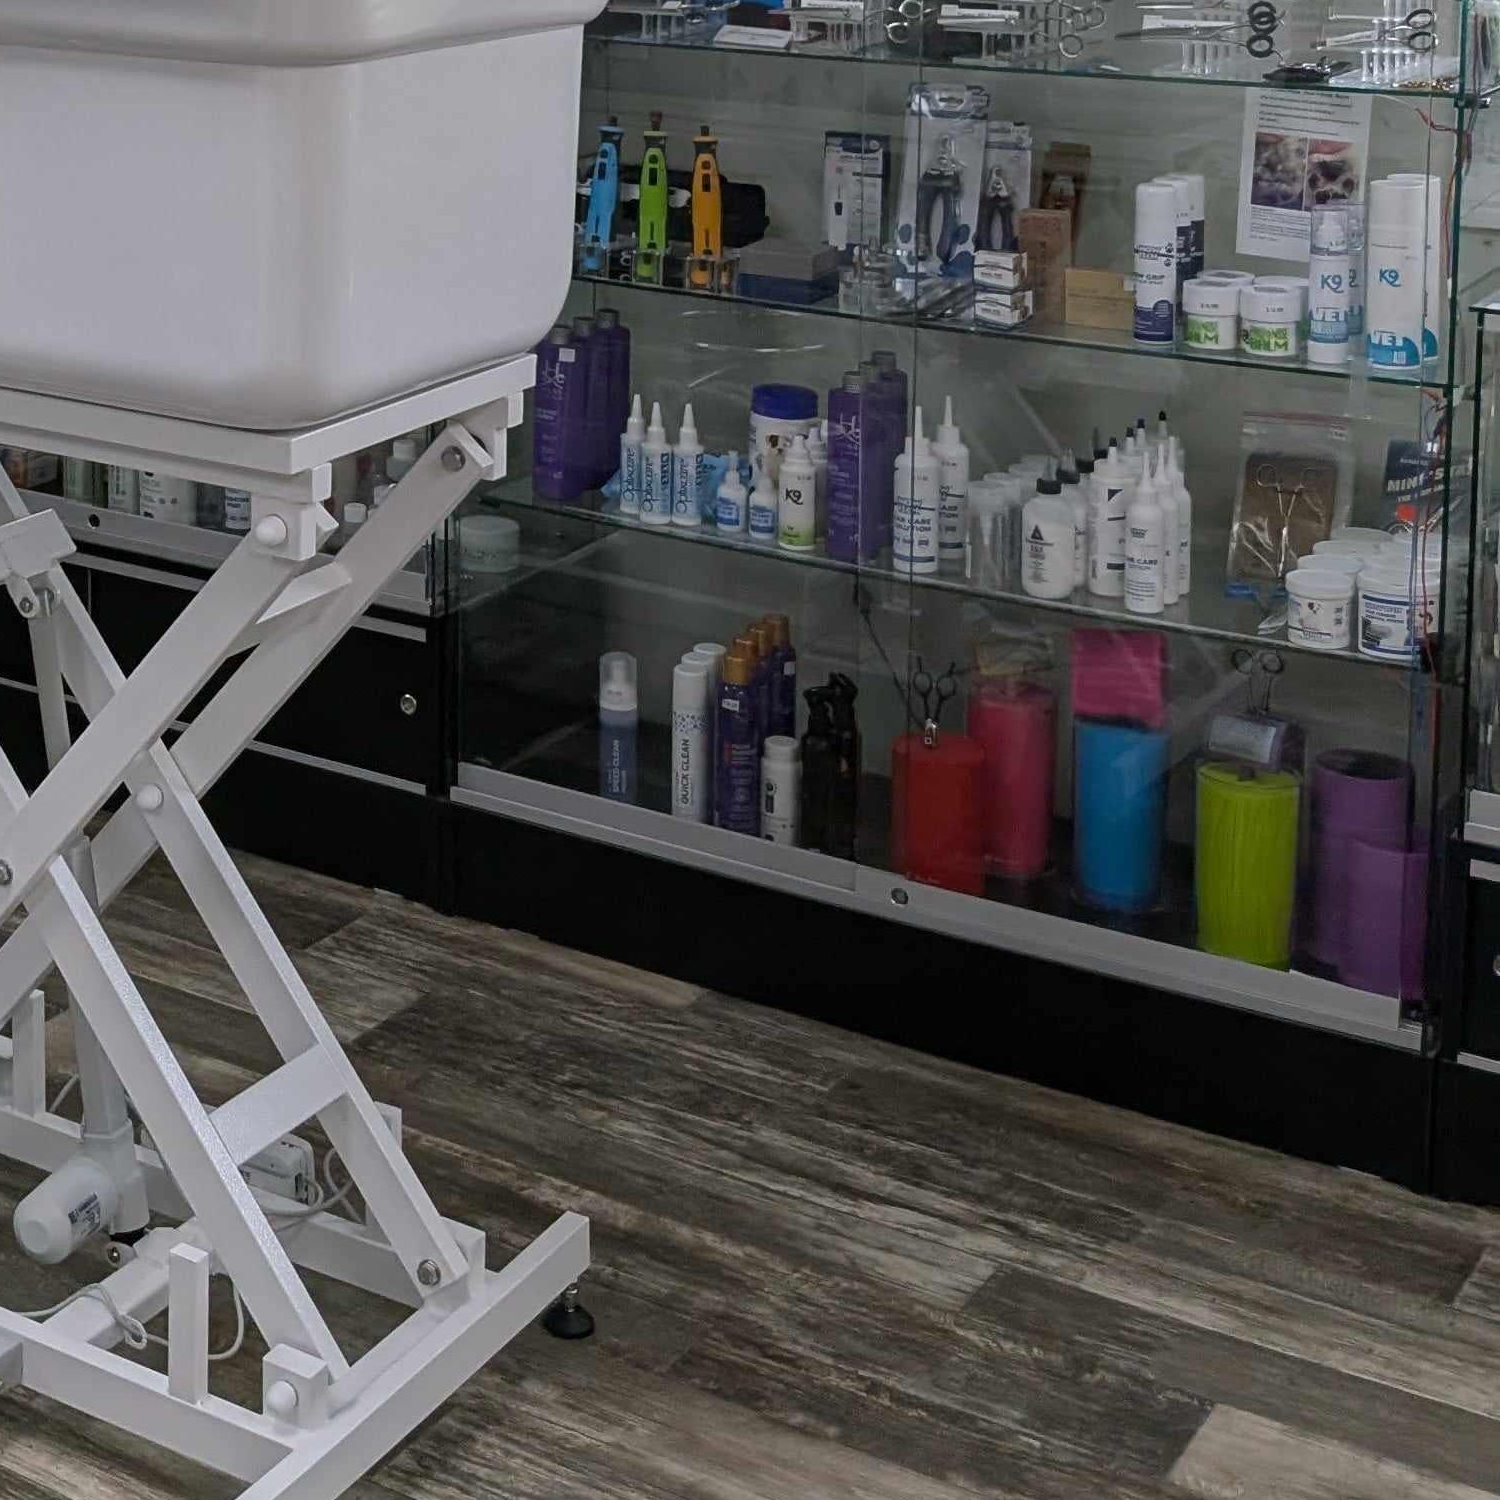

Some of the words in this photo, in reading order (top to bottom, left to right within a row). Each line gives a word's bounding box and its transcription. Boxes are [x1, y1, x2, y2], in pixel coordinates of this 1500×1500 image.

[1320, 274, 1345, 293] K9
[1380, 267, 1402, 287] K9
[785, 488, 804, 506] K9
[681, 738, 690, 771] CLEAN
[681, 773, 690, 805] QUICK
